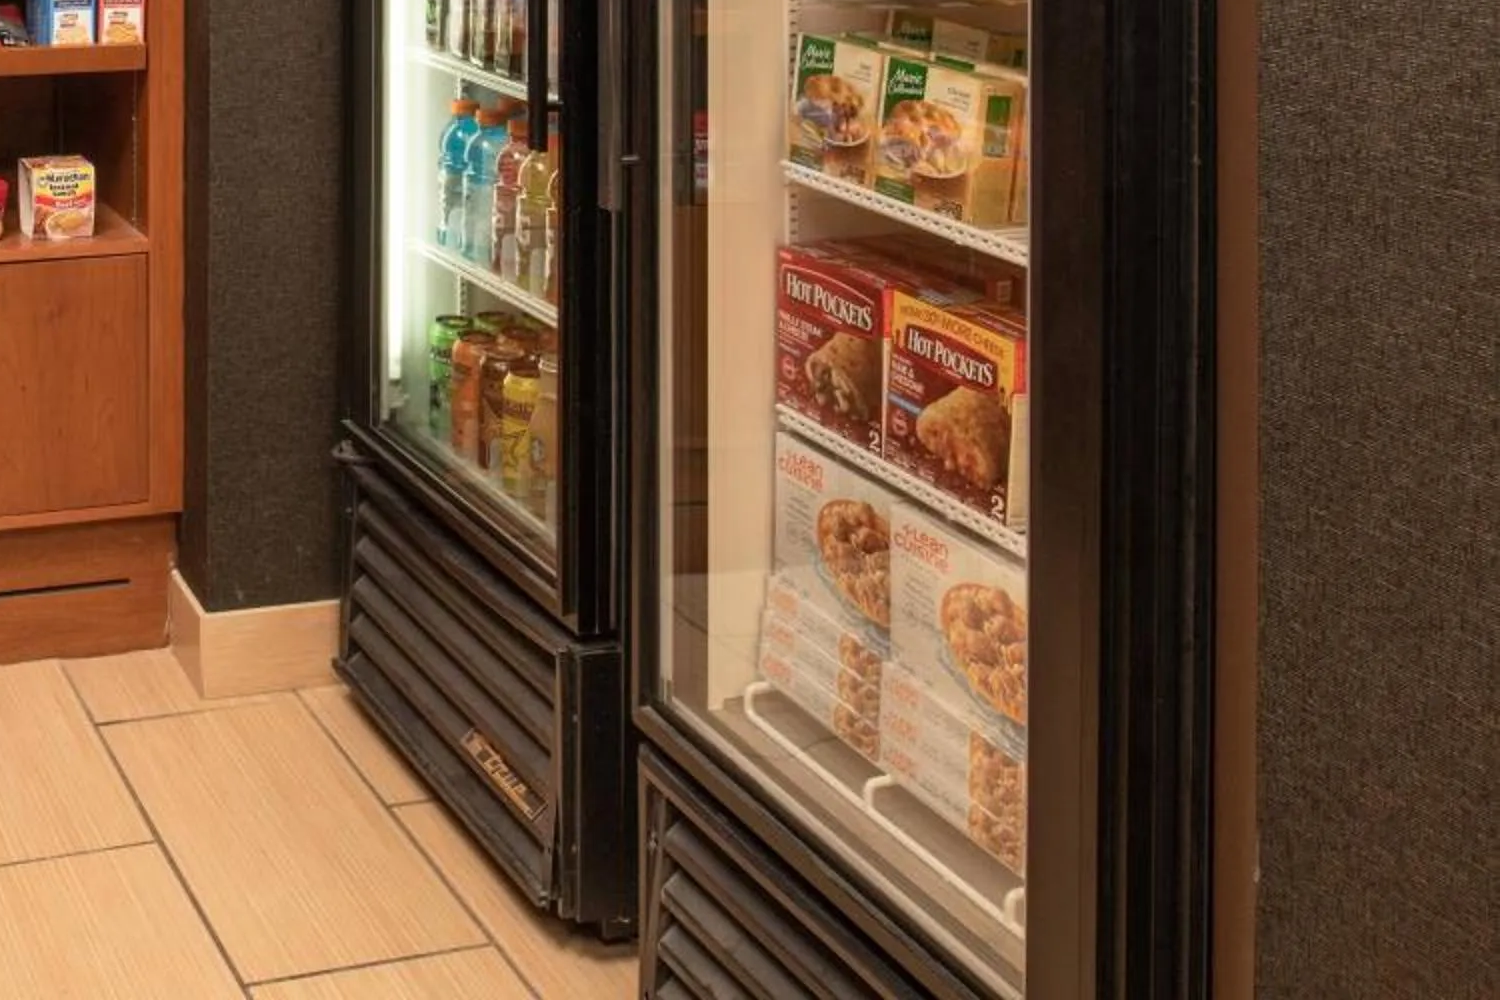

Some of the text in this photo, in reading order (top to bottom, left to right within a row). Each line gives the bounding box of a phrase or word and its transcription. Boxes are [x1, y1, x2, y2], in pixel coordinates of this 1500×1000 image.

[786, 271, 812, 305] HOT
[813, 283, 873, 332] POCKETS
[907, 327, 934, 359] HOT
[934, 339, 994, 387] POCKETS
[868, 431, 881, 451] 2
[990, 494, 1005, 514] 2
